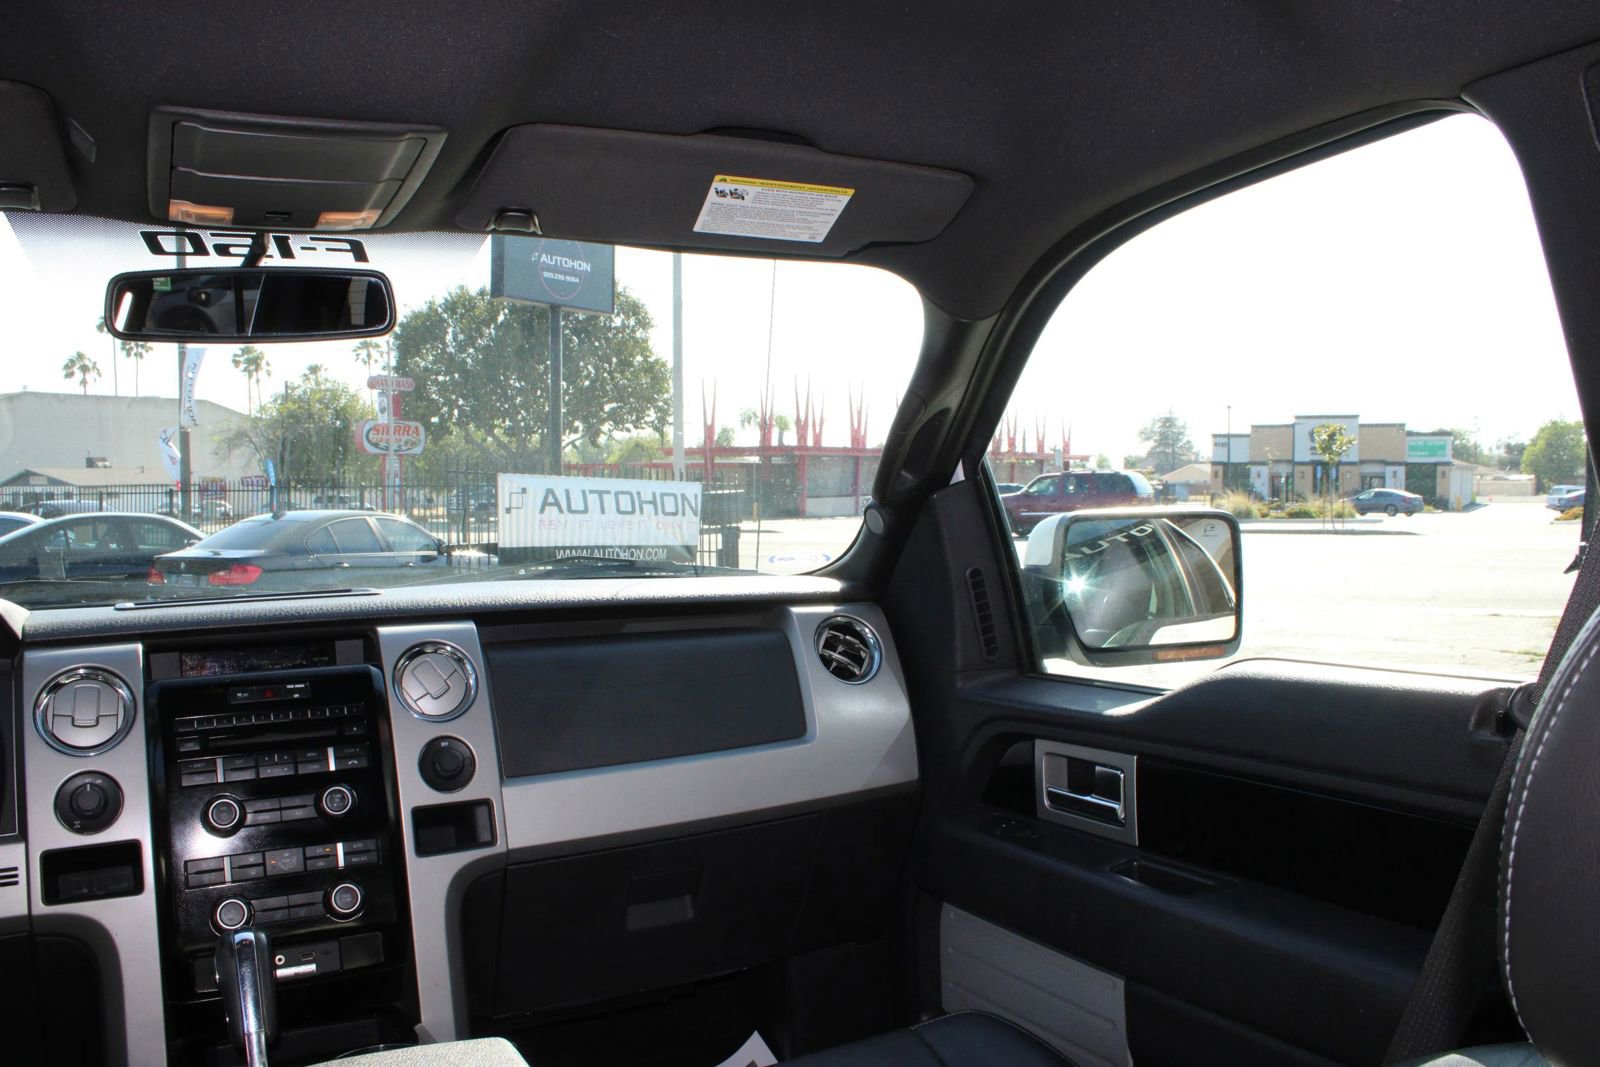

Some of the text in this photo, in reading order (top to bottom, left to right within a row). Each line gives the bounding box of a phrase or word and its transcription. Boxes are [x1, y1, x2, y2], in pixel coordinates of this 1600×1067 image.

[540, 253, 591, 272] AUTOHON
[539, 488, 699, 517] AUTOHON
[556, 548, 667, 561] WWW.AUTOHON.COM
